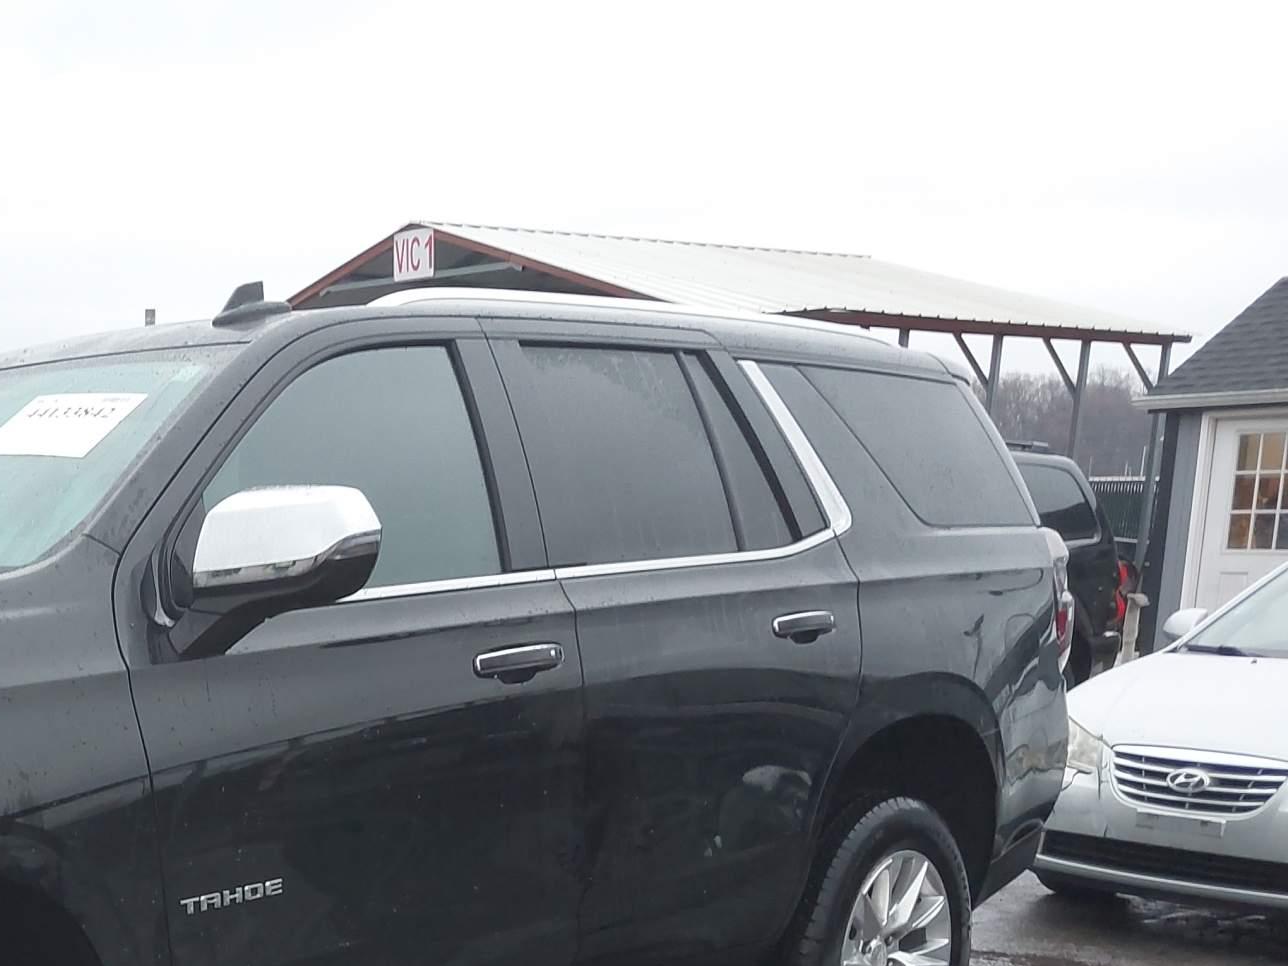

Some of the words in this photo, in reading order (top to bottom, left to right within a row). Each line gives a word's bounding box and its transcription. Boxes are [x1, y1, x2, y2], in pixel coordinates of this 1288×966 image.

[395, 236, 420, 273] VIC
[424, 234, 433, 269] 1
[179, 878, 283, 915] TAHOE
